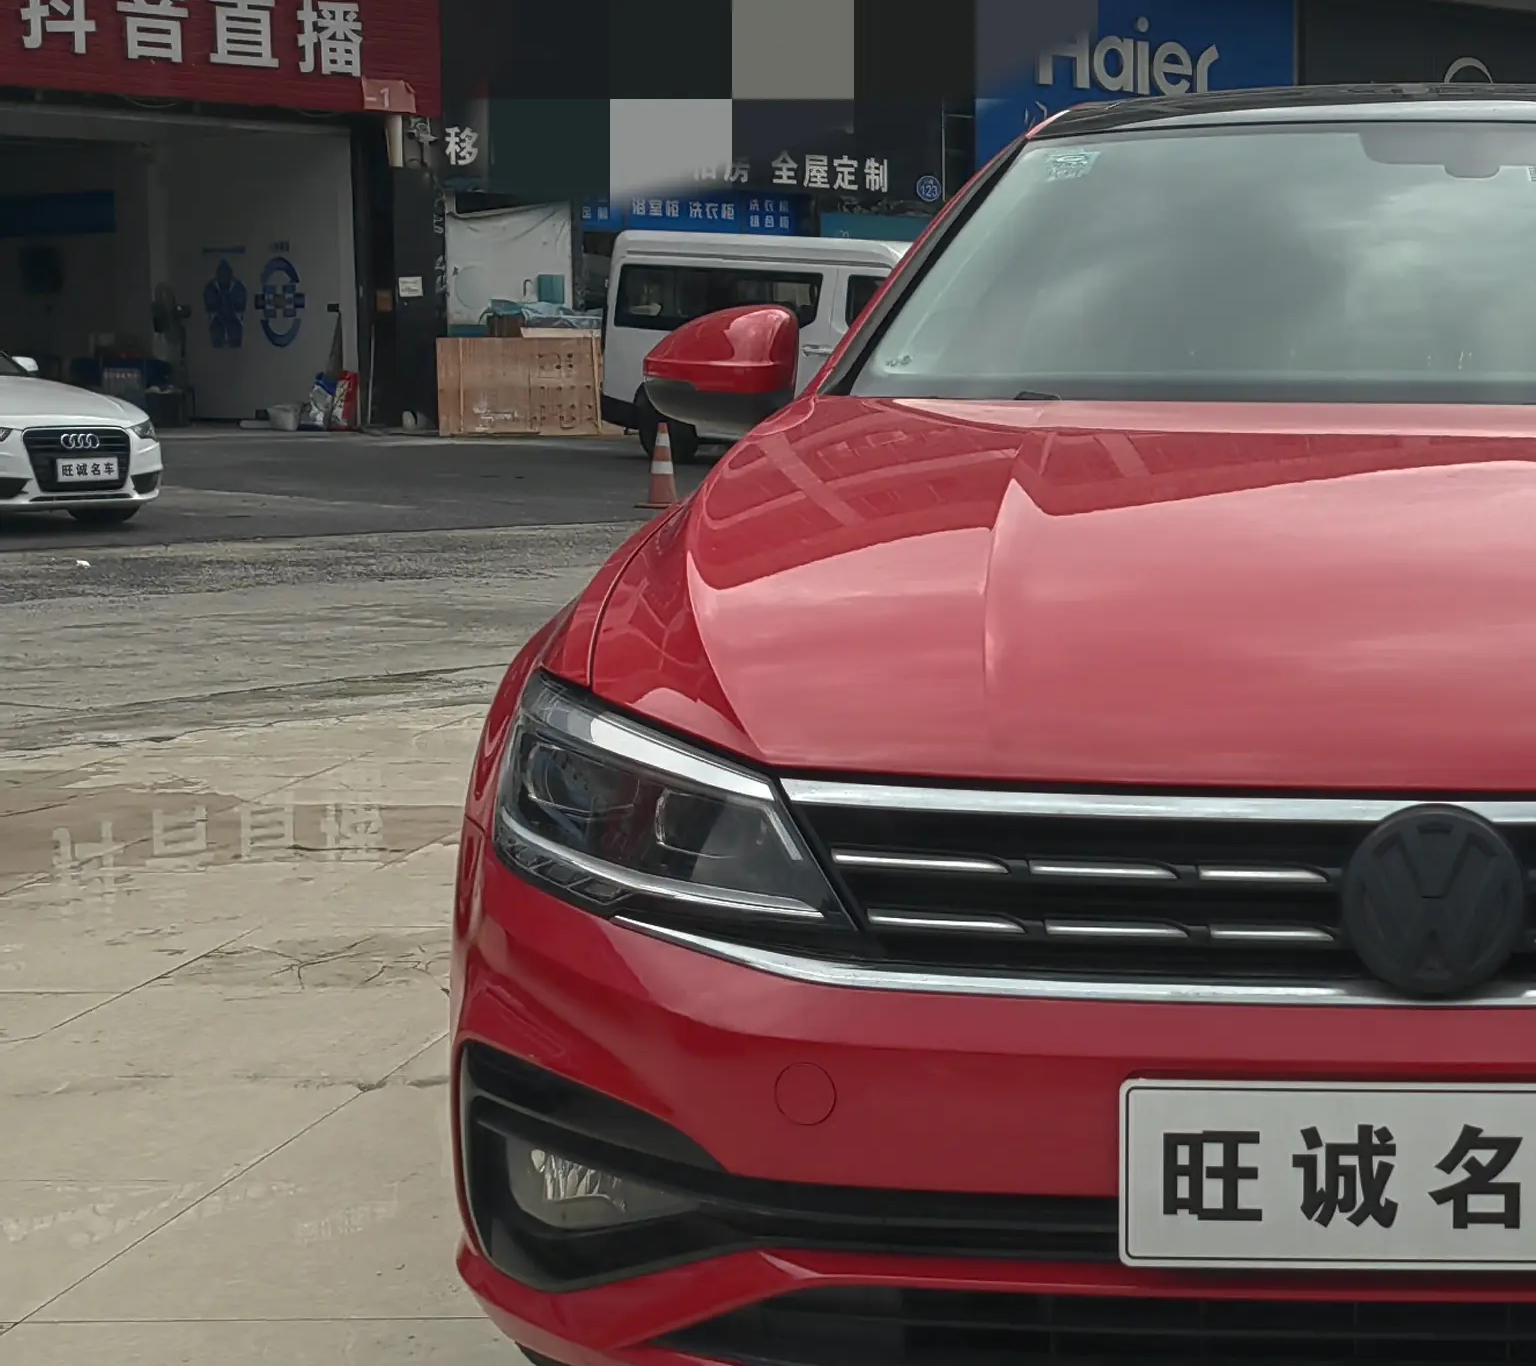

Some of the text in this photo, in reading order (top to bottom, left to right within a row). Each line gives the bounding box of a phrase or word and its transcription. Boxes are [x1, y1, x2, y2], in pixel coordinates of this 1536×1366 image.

[1036, 17, 1220, 96] Haier
[445, 126, 480, 166] 移
[771, 151, 889, 193] 全屋定制
[62, 462, 115, 477] 旺诚名车
